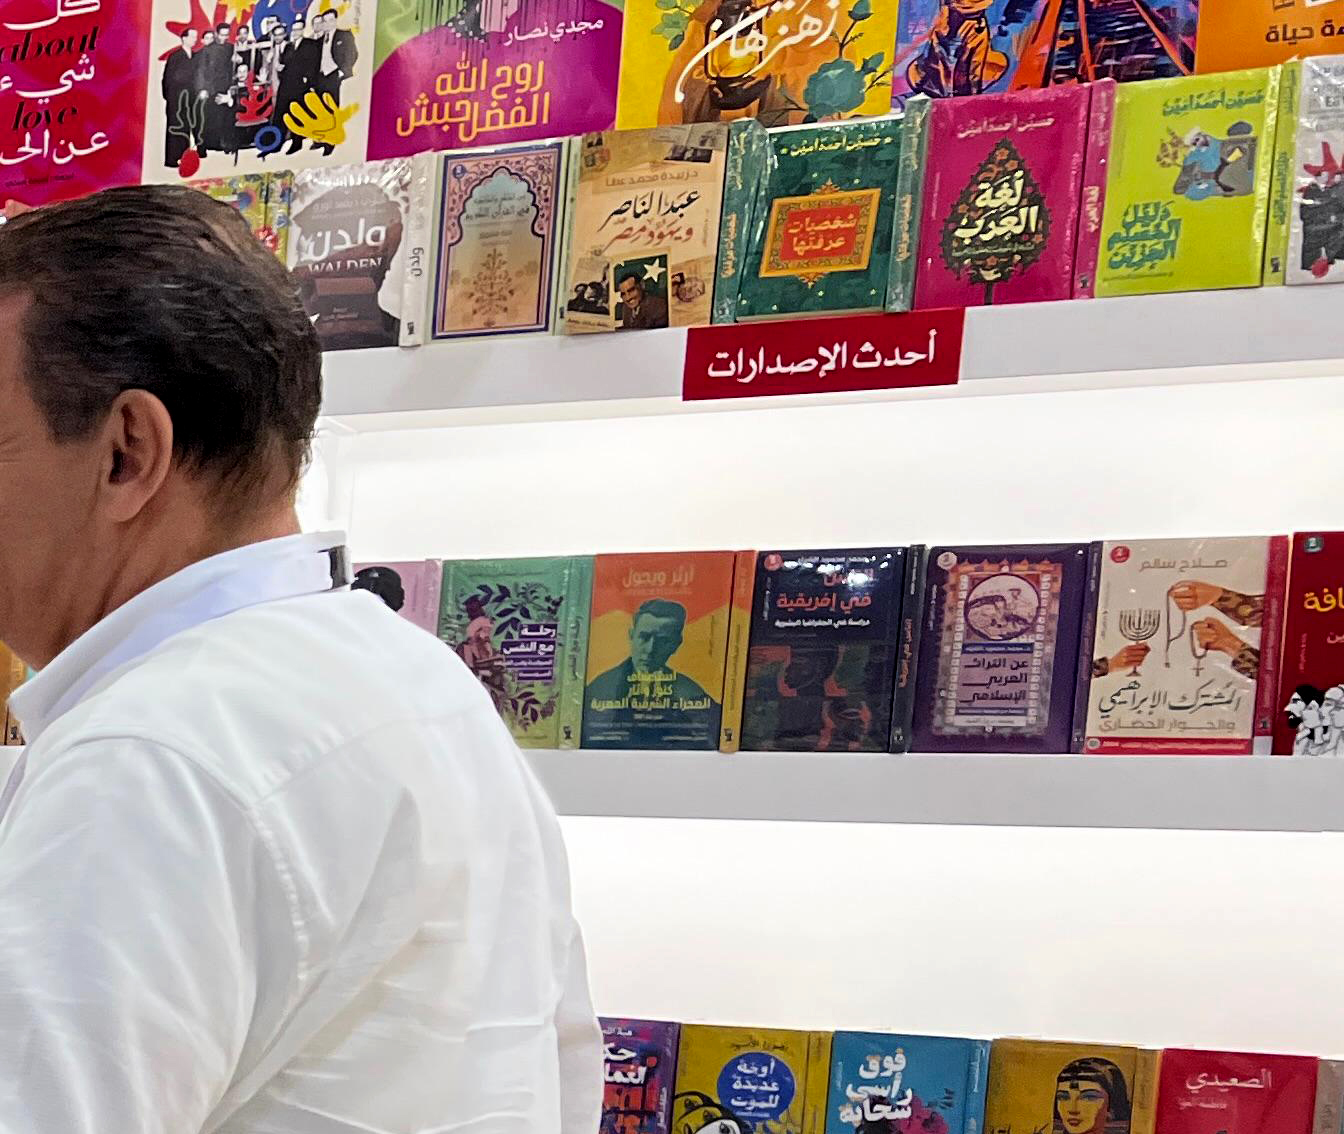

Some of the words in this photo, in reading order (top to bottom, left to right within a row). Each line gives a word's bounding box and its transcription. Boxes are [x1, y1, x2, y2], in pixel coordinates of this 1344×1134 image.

[551, 16, 604, 44] مجدي
[436, 53, 486, 96] الله
[491, 59, 544, 99] روح
[11, 99, 79, 132] love
[457, 92, 550, 142] الفضل
[53, 133, 110, 162] عن
[298, 224, 387, 262] ولدن
[712, 336, 848, 384] الإصدارات
[851, 331, 937, 371] أحدث
[521, 625, 556, 639] رحلة
[964, 656, 1006, 671] التراث
[1010, 658, 1029, 671] عن
[859, 1048, 907, 1079] فوق
[732, 1076, 779, 1091] عديدة
[1185, 1070, 1271, 1092] الصعيدي
[730, 1095, 780, 1108] للموت
